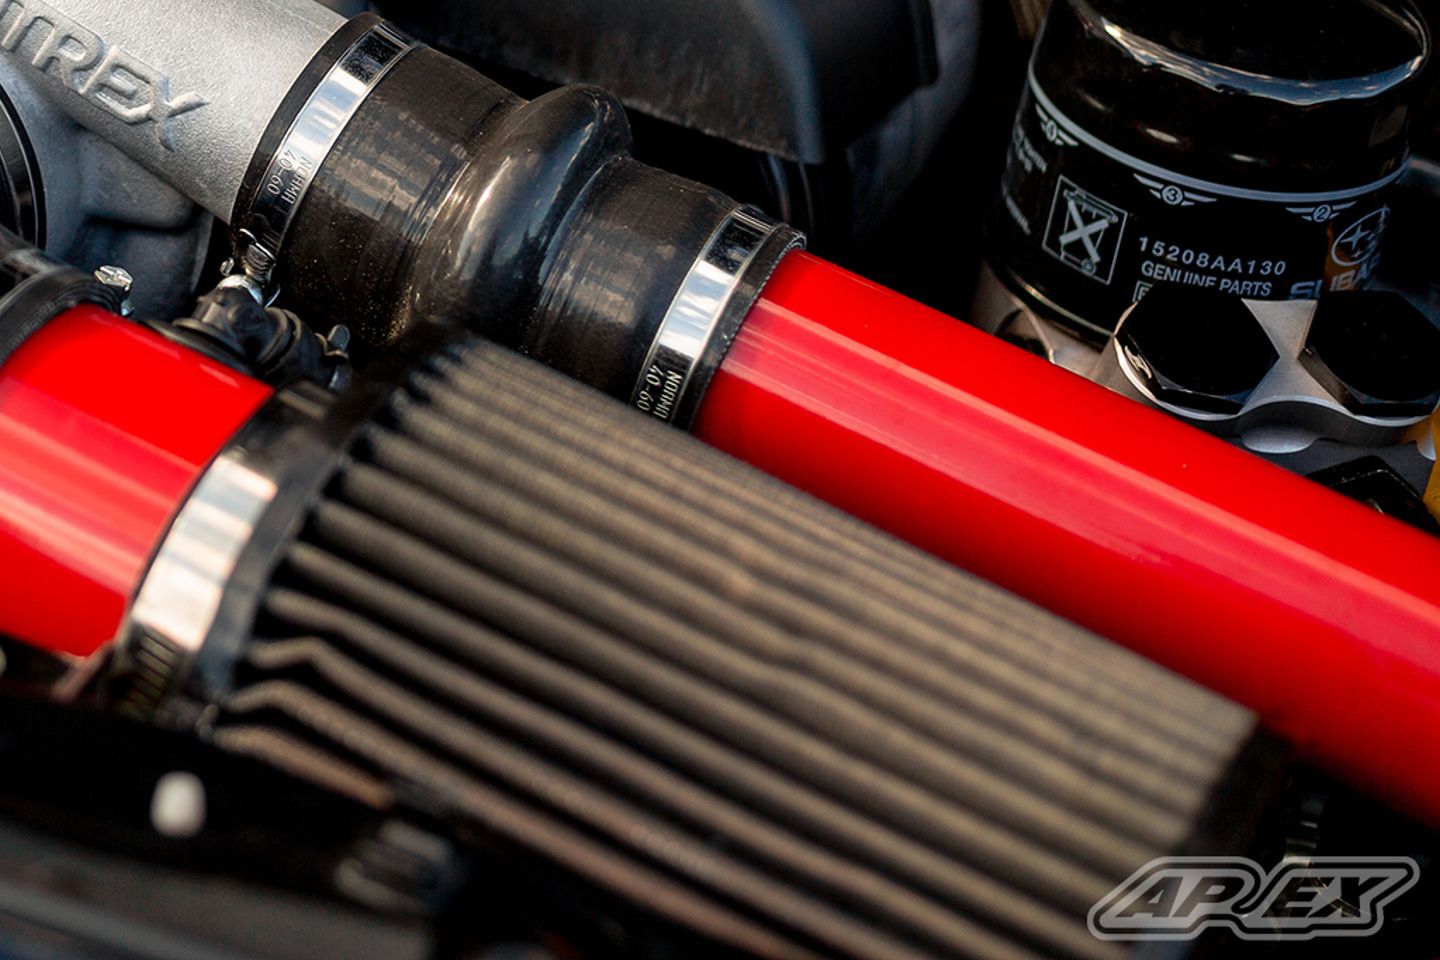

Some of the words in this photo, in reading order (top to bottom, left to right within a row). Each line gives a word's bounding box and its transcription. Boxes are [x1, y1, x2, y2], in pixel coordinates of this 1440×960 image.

[266, 149, 296, 195] 40-60
[281, 156, 313, 205] NORMA
[1139, 236, 1287, 275] 15208AA130
[1219, 277, 1273, 297] PARTS
[636, 364, 664, 411] 40-60
[652, 370, 682, 419] NORMA
